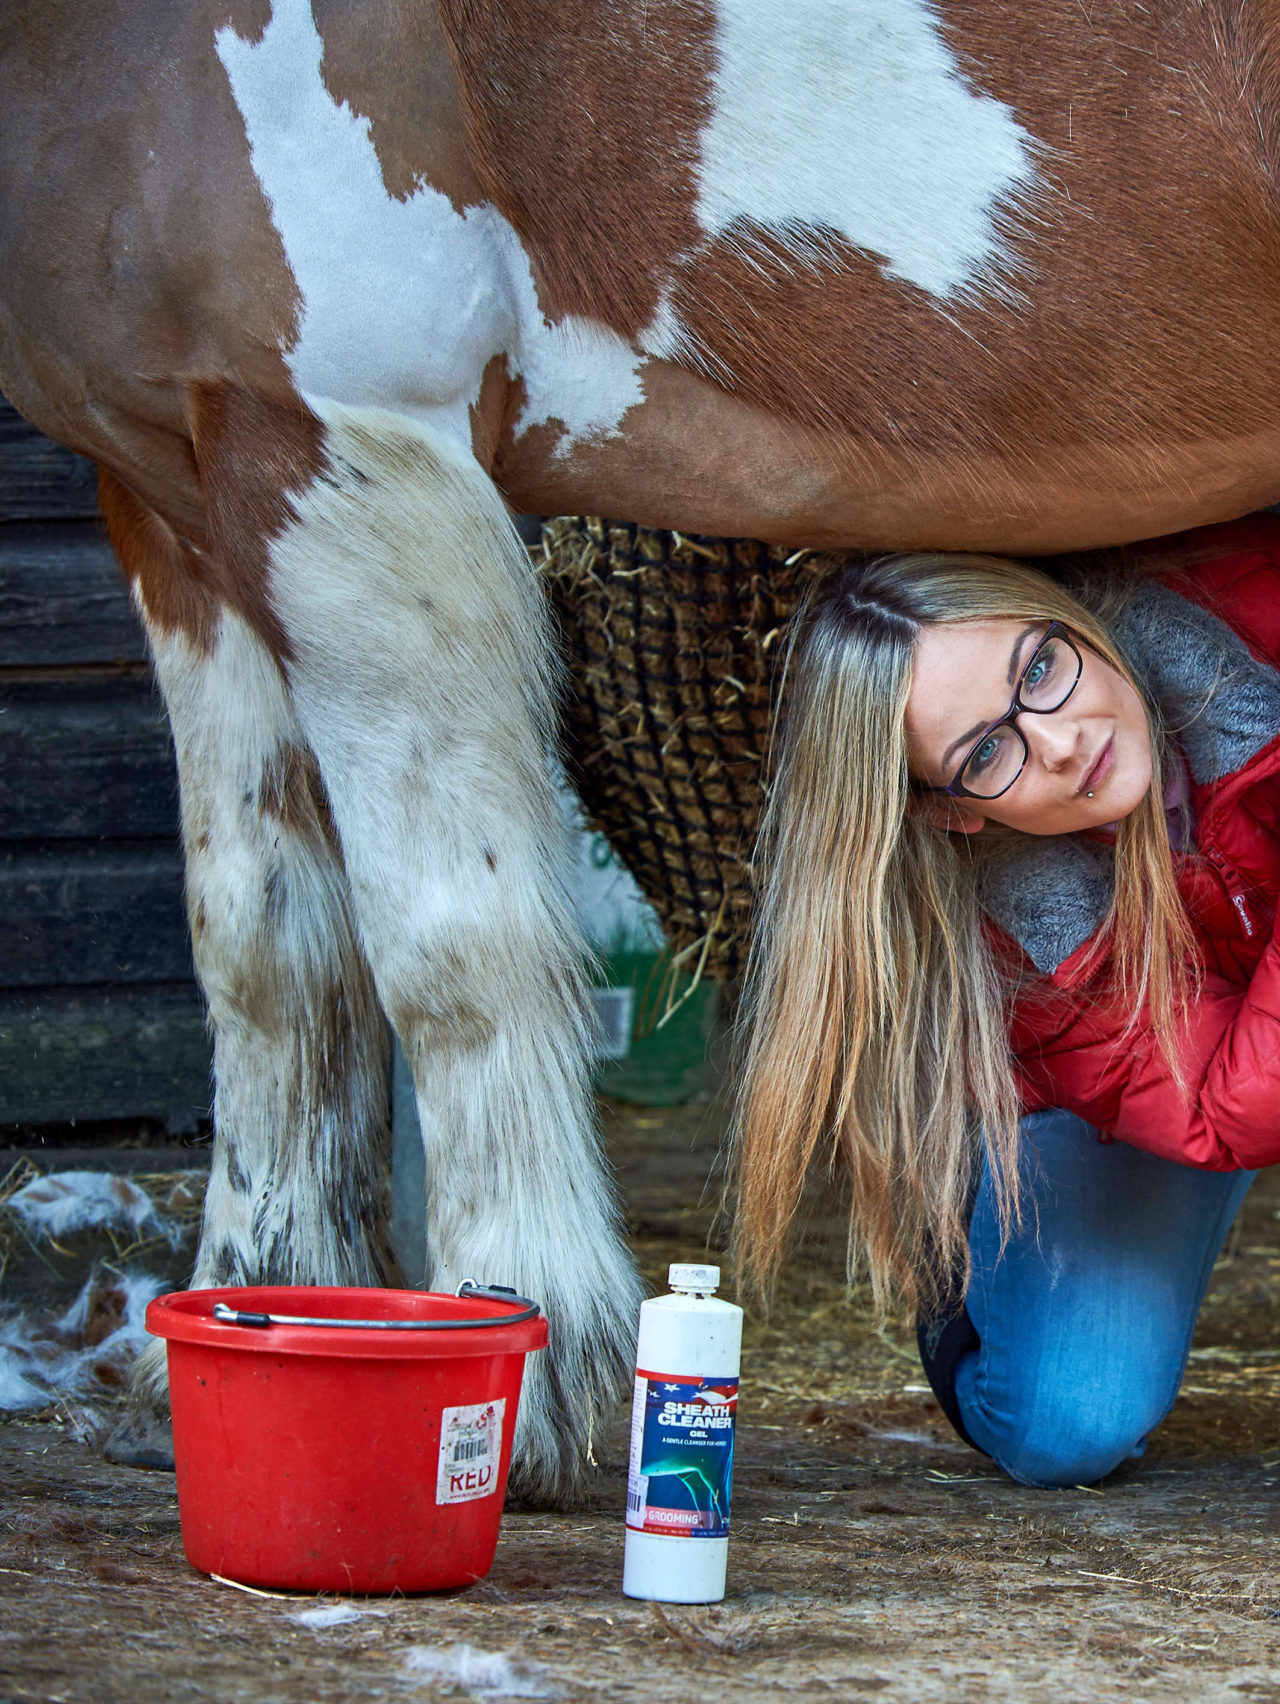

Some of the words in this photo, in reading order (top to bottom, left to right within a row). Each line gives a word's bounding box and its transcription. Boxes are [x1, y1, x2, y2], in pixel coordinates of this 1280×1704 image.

[663, 1401, 730, 1417] SHEATH
[657, 1412, 732, 1429] CLEANER
[666, 1437, 684, 1445] GENTLE
[689, 1430, 708, 1438] GEL
[450, 1464, 491, 1492] RED
[648, 1510, 699, 1525] GROOMING
